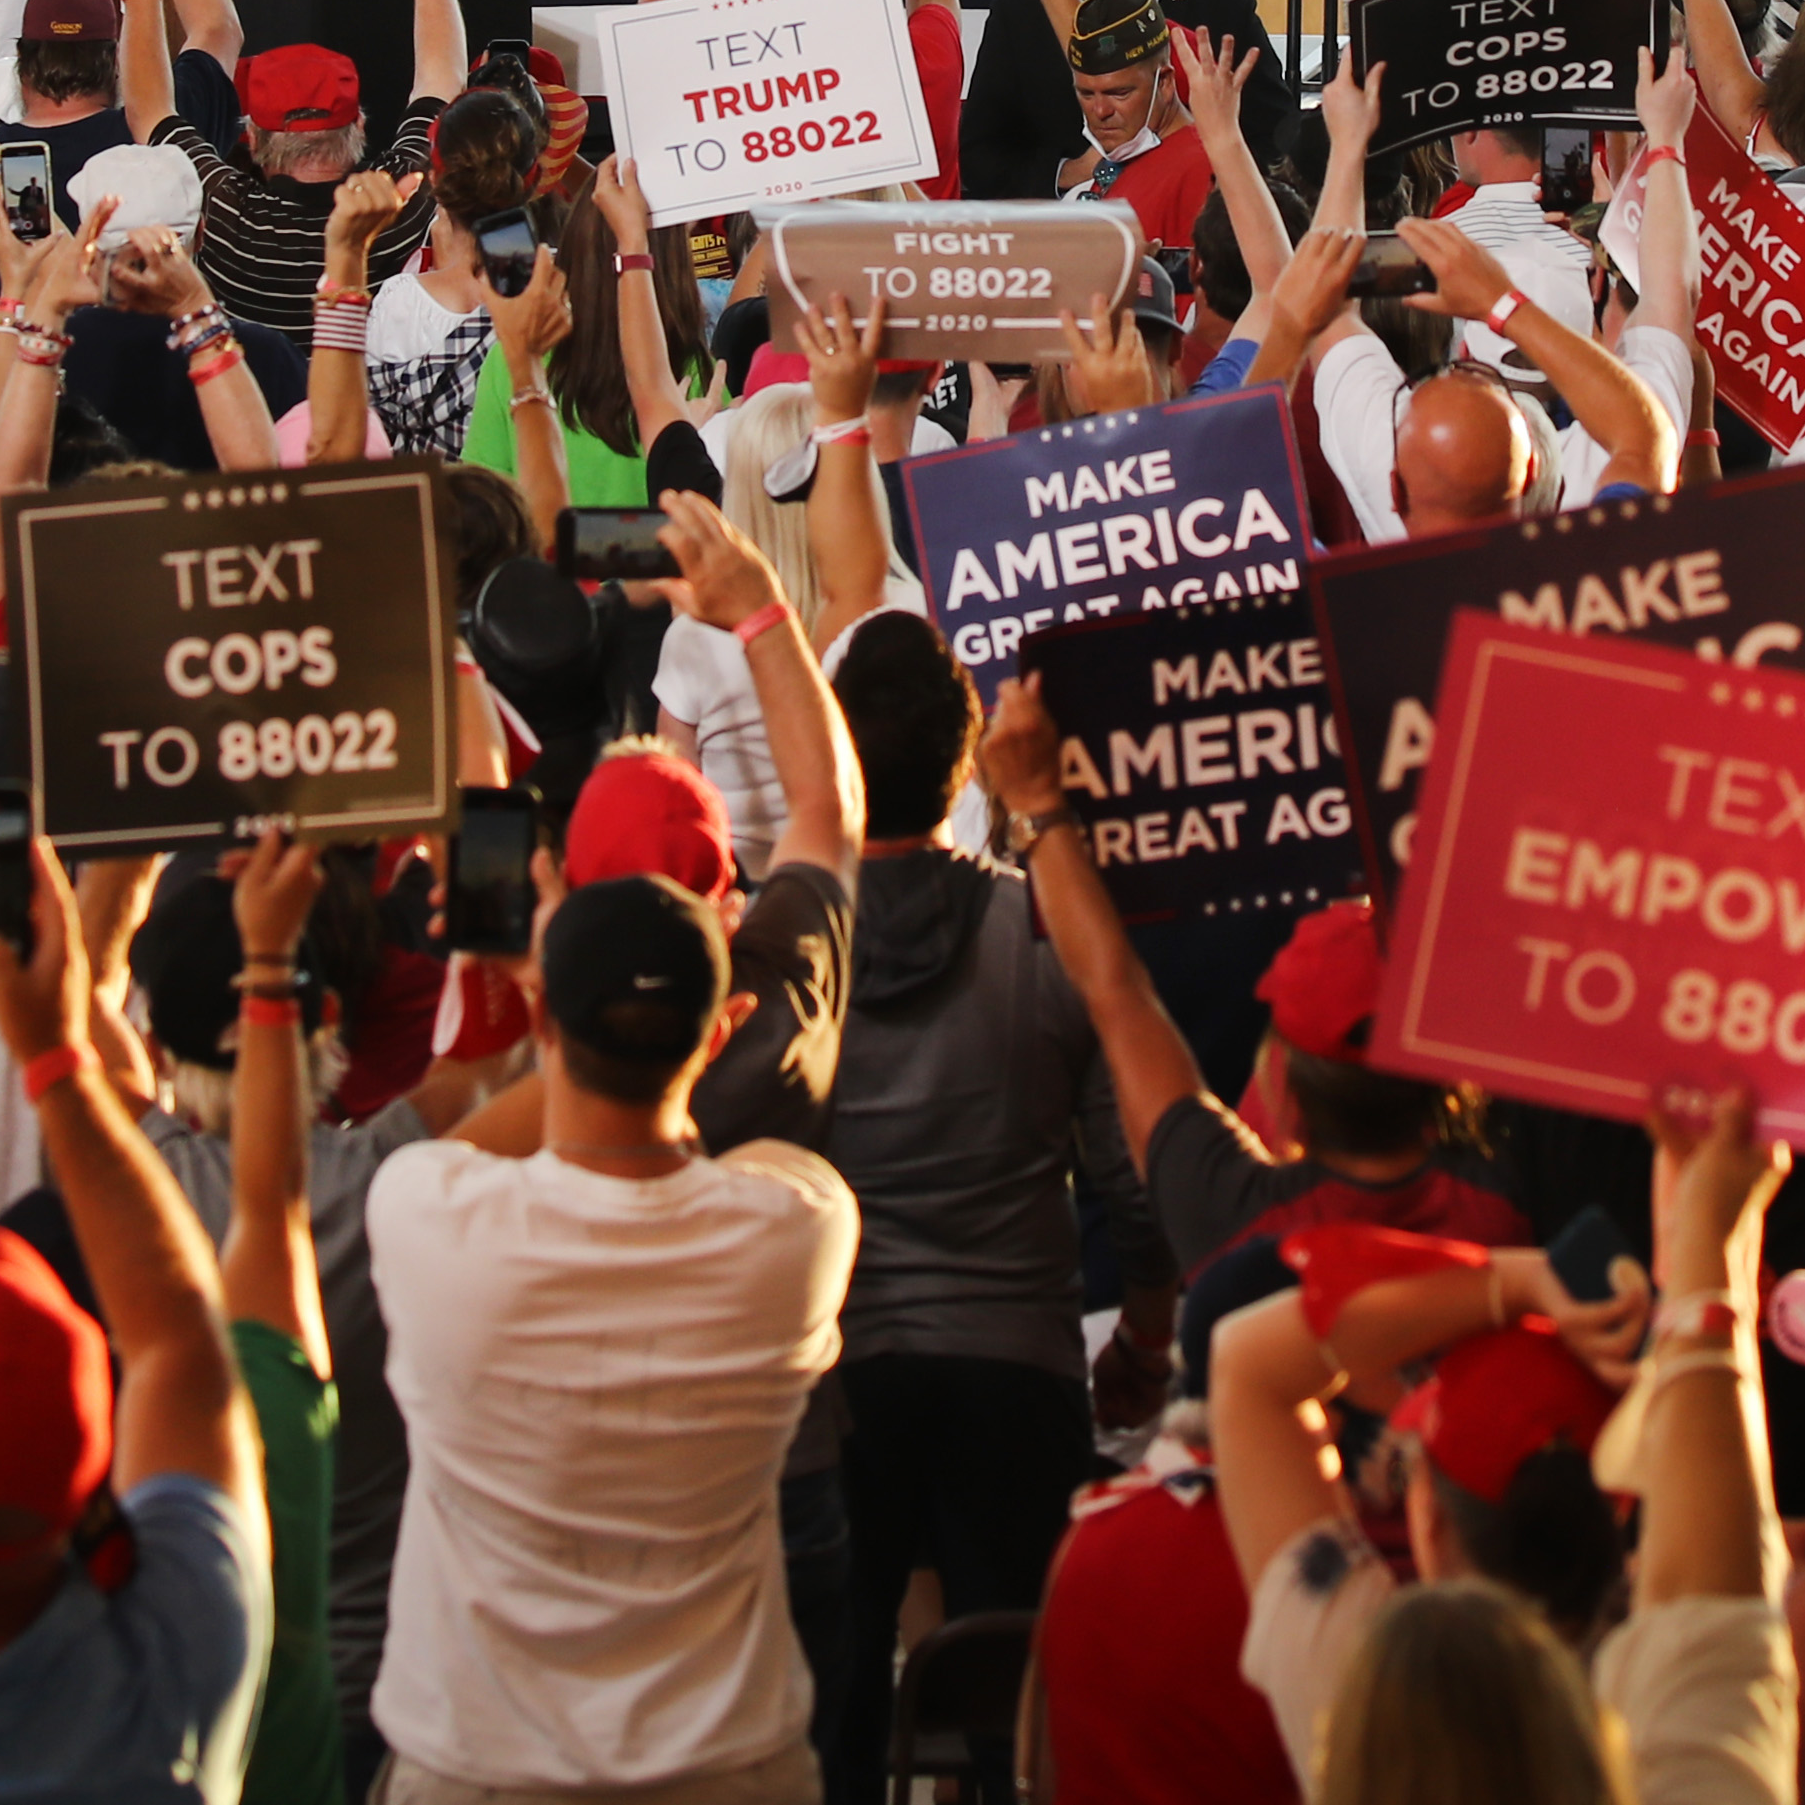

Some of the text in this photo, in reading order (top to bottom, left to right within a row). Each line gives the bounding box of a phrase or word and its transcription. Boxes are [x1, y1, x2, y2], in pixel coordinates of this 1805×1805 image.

[696, 21, 808, 73] TEXT
[1125, 46, 1145, 61] NEW
[1445, 28, 1568, 67] COPS
[683, 68, 842, 125] TRUMP
[1402, 59, 1614, 117] TO 88022
[1482, 110, 1525, 126] 2020
[665, 111, 883, 177] TO 88022
[764, 182, 804, 197] 2020
[894, 232, 1014, 256] FIGHT
[1707, 176, 1802, 282] MAKE
[862, 266, 1054, 300] TO 88022
[925, 314, 988, 333] 2020
[1024, 449, 1177, 518] MAKE
[160, 537, 322, 612] TEXT
[946, 487, 1292, 611] AMERICA
[1499, 549, 1734, 640] MAKE
[164, 624, 338, 701] COPS
[1150, 638, 1324, 706] MAKE
[98, 707, 398, 790] TO 88022
[1516, 935, 1637, 1028] TO
